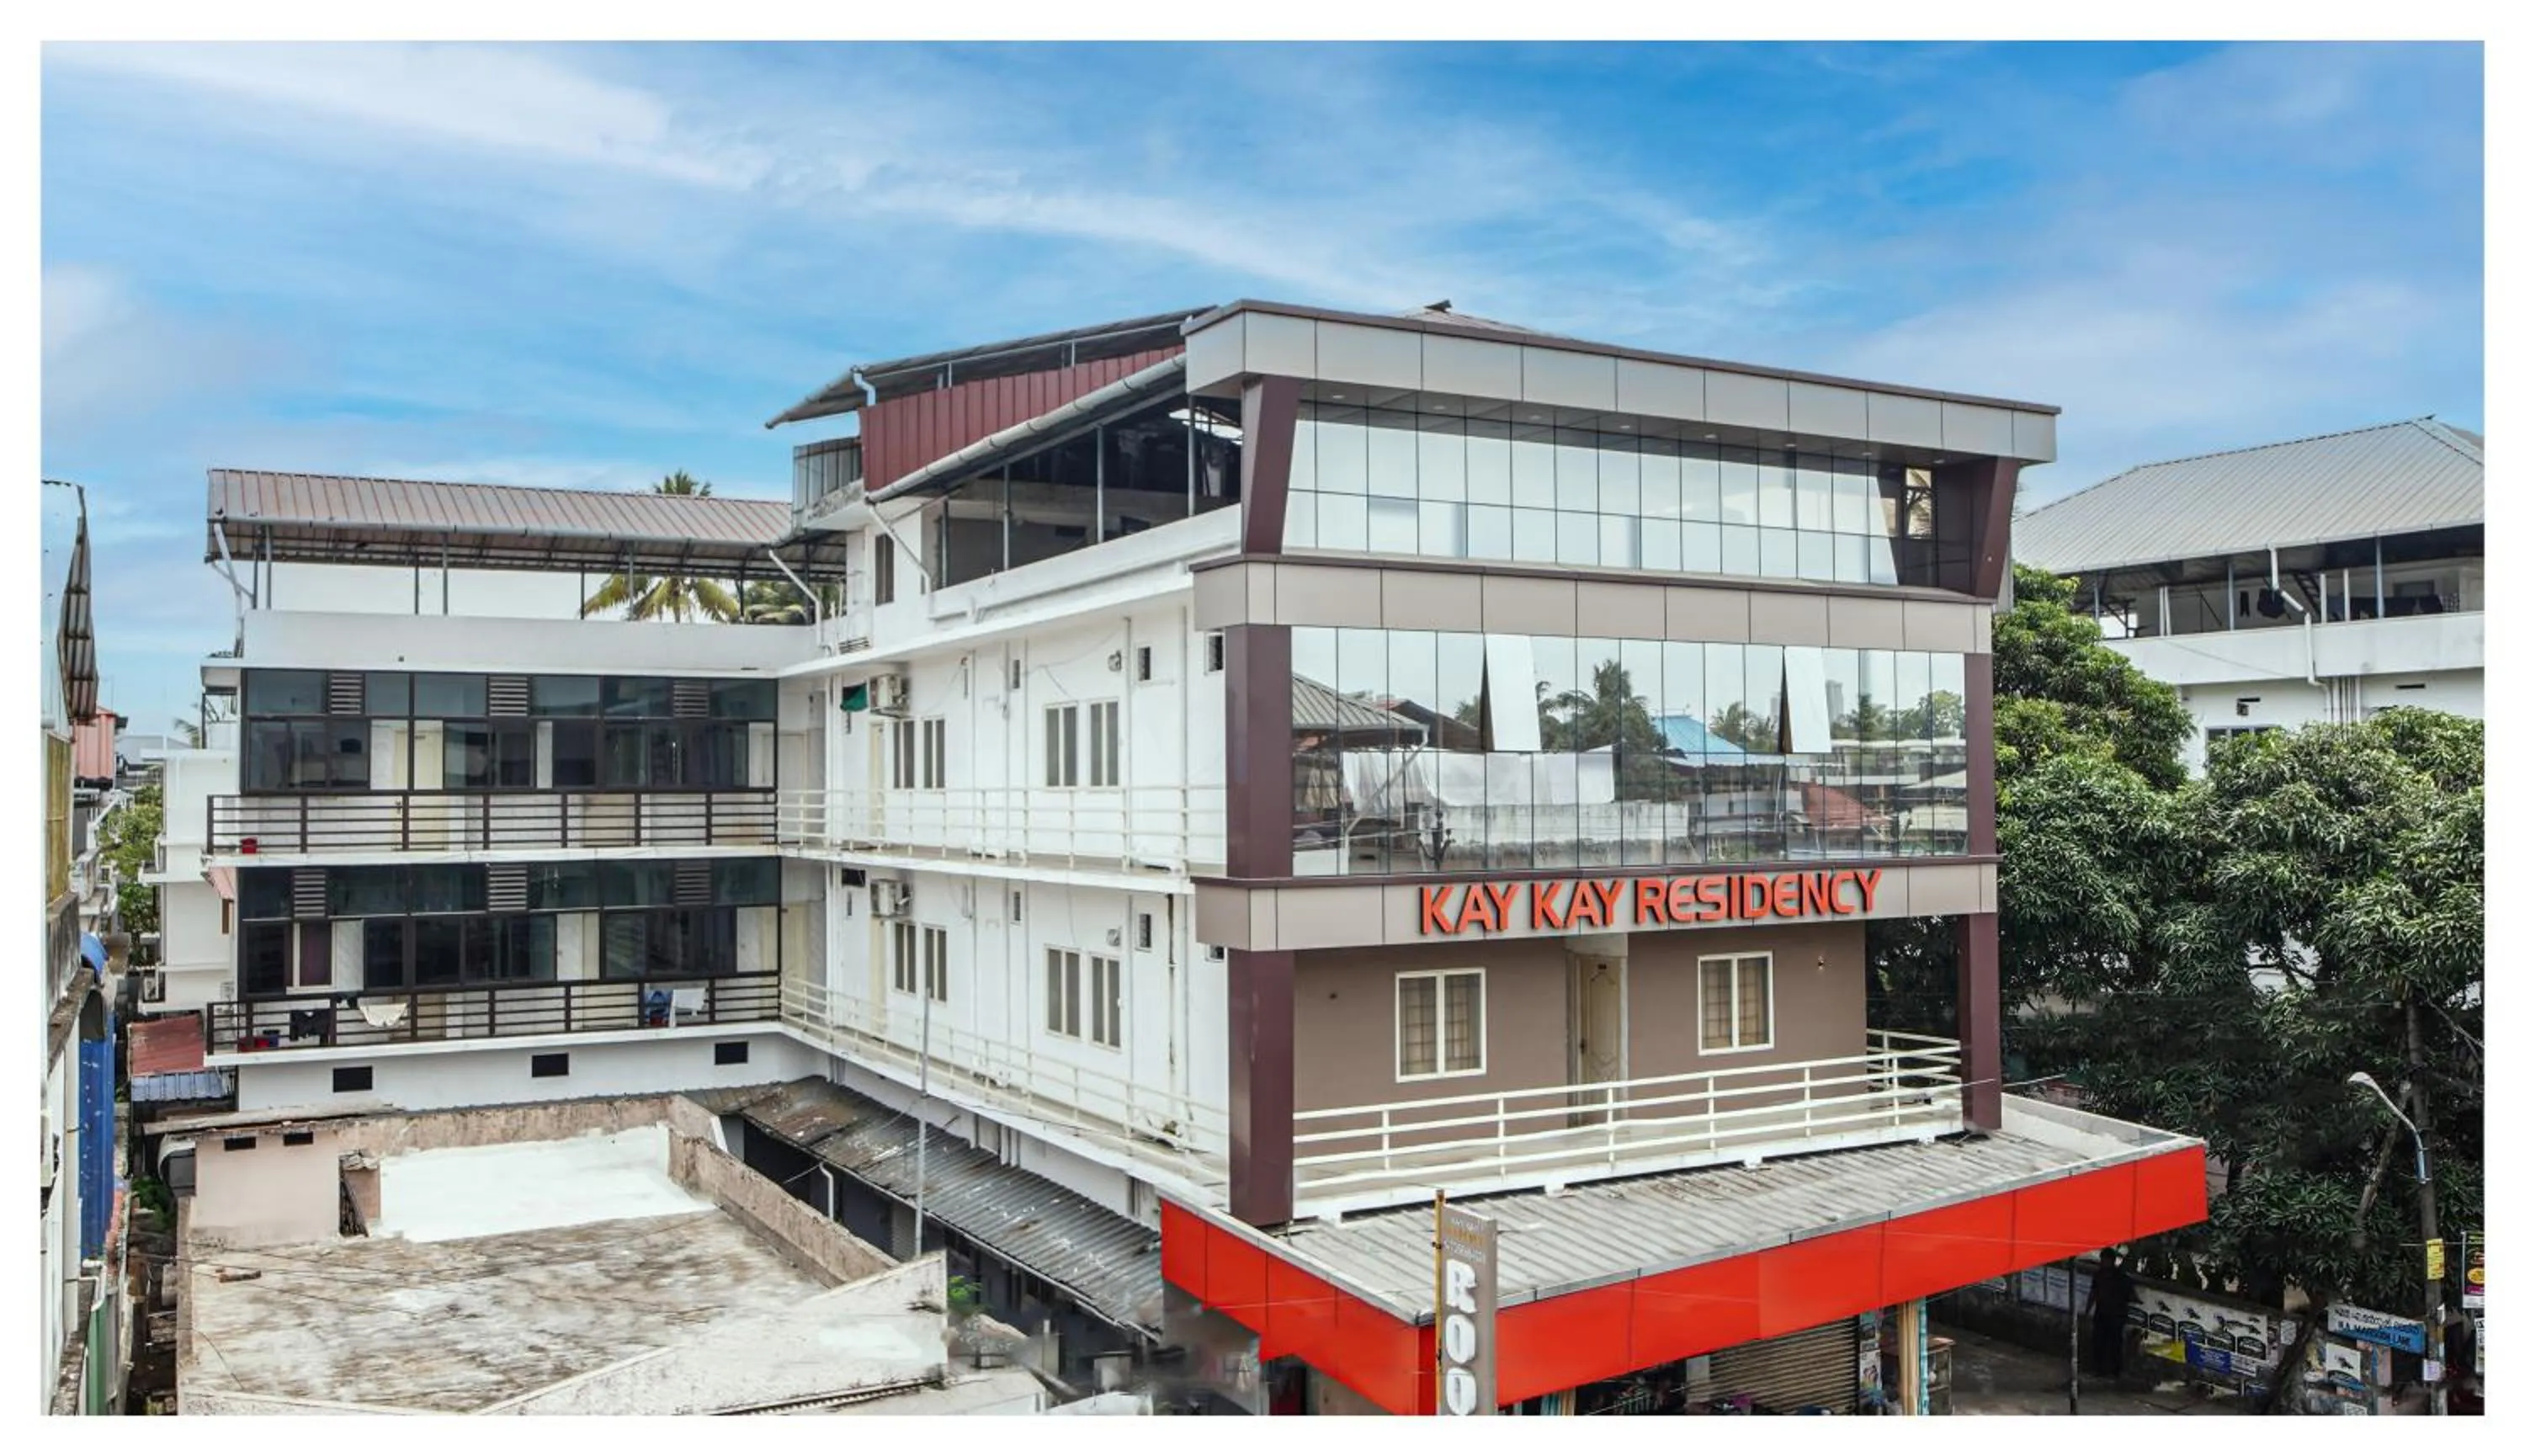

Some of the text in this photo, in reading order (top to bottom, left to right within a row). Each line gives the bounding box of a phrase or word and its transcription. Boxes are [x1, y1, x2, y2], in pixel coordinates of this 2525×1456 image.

[1421, 868, 1882, 934] KAY KAY RESIDENCY
